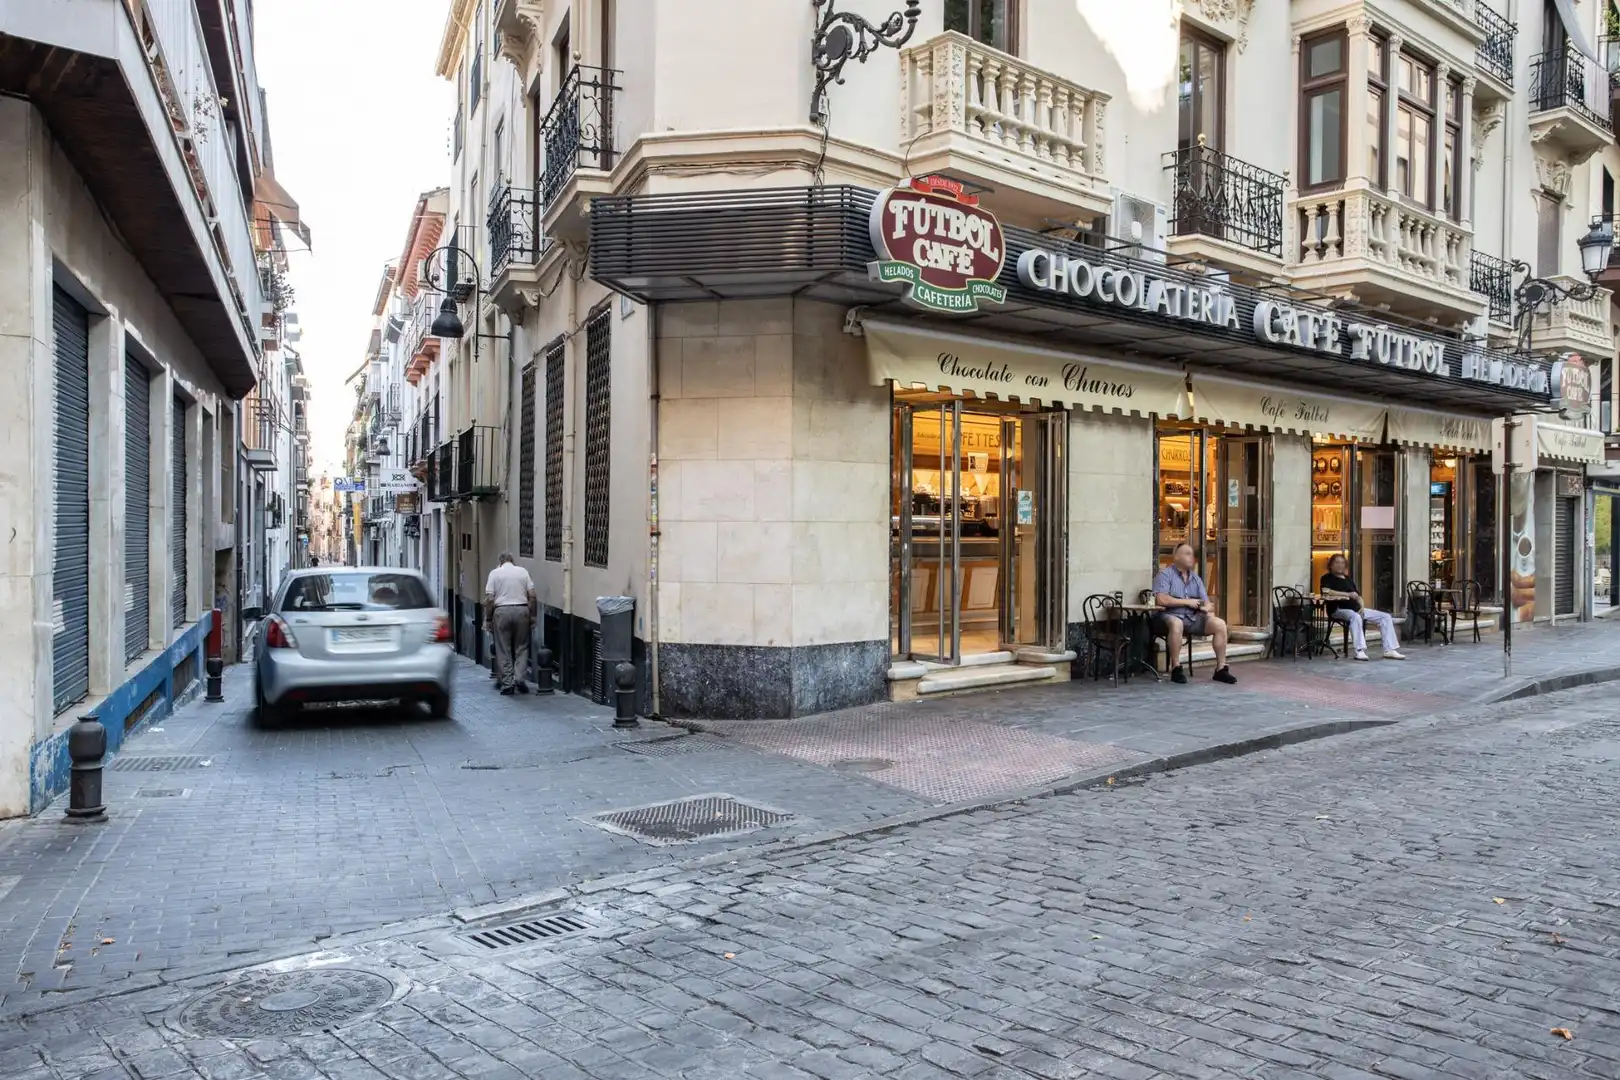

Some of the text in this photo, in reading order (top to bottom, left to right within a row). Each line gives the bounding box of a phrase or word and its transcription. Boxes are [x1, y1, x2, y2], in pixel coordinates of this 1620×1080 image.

[889, 197, 999, 263] FÚTBOL
[884, 266, 914, 279] HELADOS
[912, 238, 974, 276] CAFÉ
[917, 285, 972, 308] CAFETERÍA
[972, 283, 1003, 299] CHOCOLATES
[1254, 299, 1343, 355] CAFÉ
[936, 351, 1136, 399] Chocolate con Churros
[1260, 395, 1286, 424] Café
